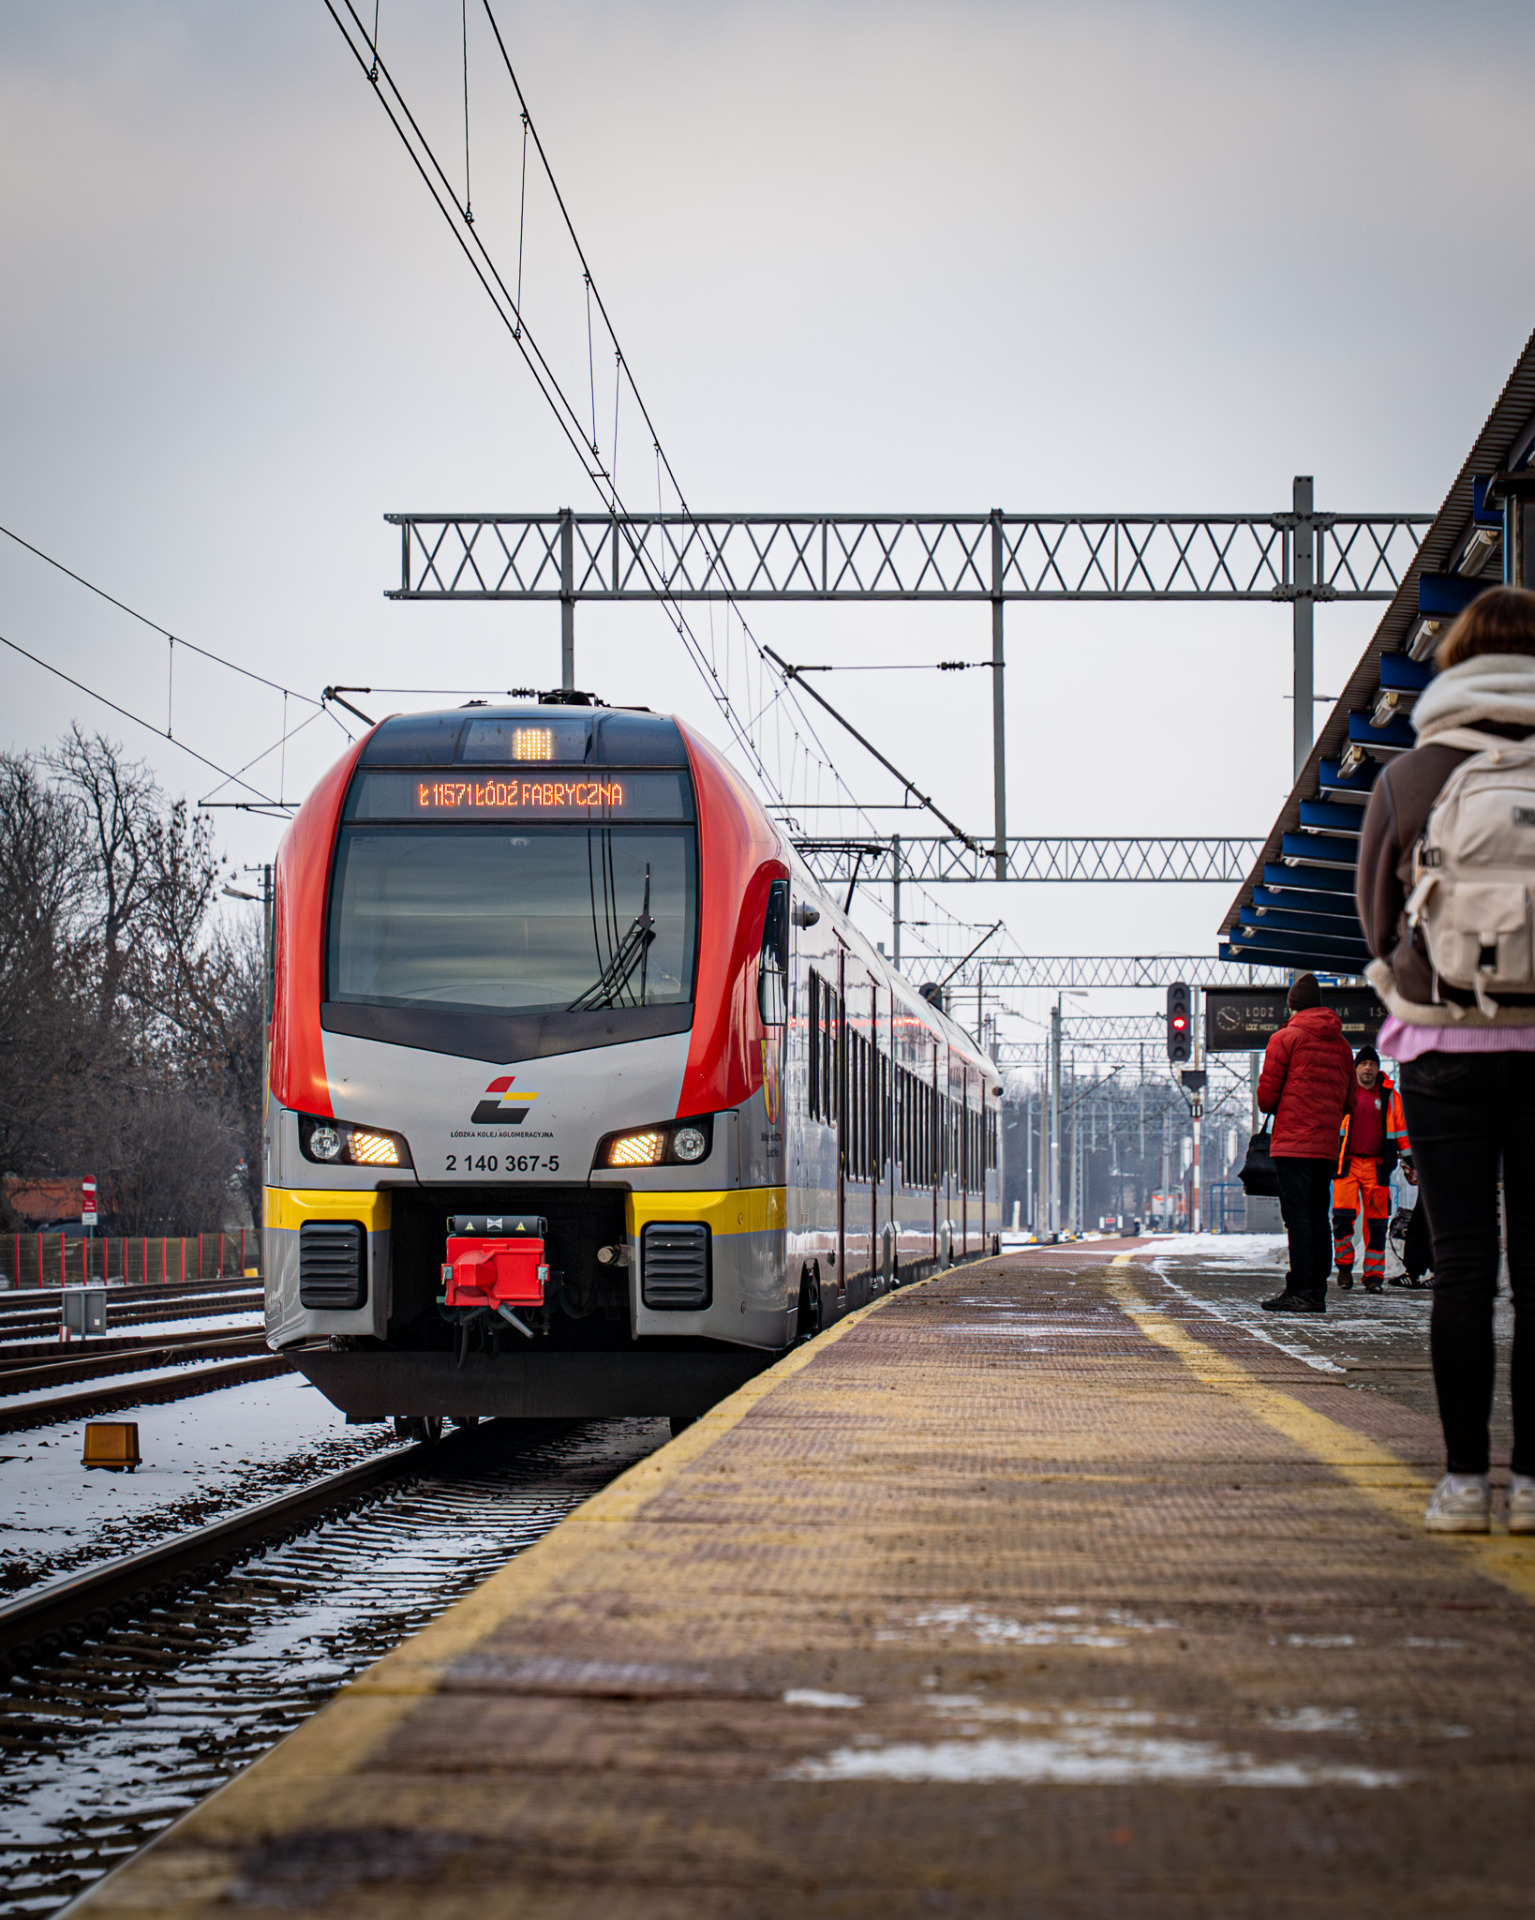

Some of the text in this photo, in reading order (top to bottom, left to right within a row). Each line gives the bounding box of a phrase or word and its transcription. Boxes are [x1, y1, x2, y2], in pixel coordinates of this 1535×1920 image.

[433, 783, 472, 806] 11571
[476, 780, 518, 806] ŁÓDŹ
[522, 783, 622, 806] FABRYCZNA
[450, 1130, 476, 1138] ŁÓDZKA
[445, 1155, 560, 1172] 2 140 367-5
